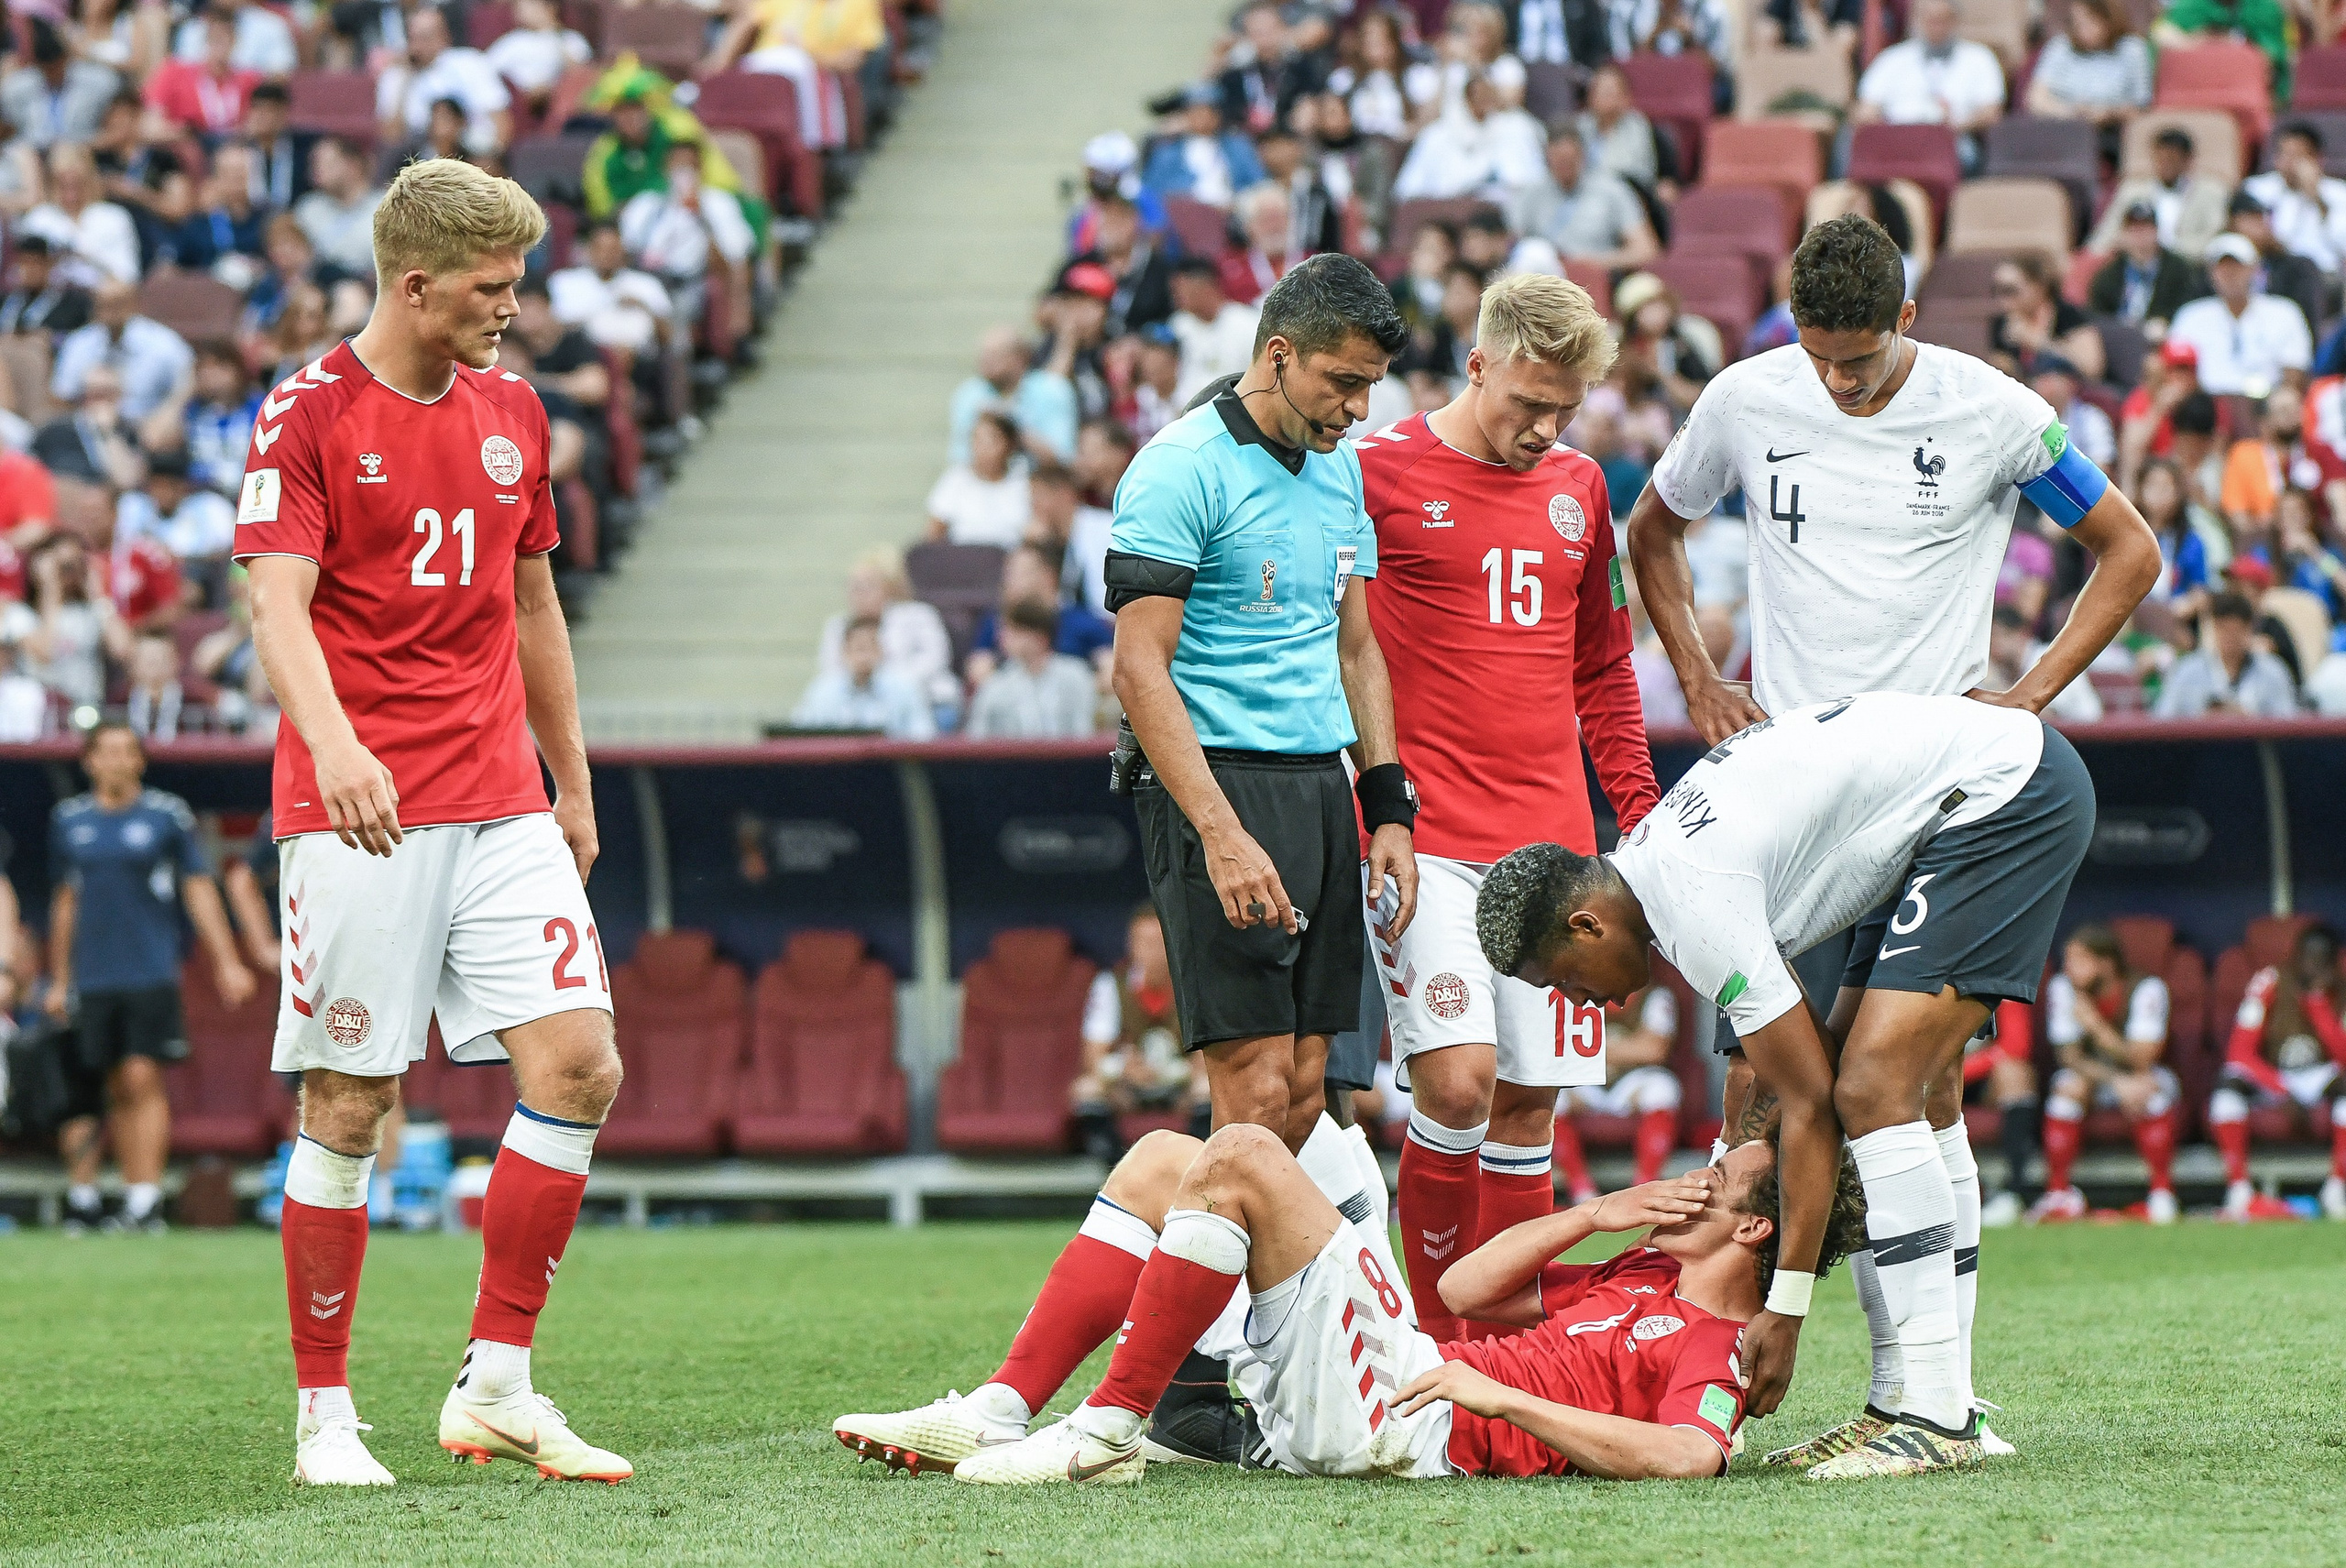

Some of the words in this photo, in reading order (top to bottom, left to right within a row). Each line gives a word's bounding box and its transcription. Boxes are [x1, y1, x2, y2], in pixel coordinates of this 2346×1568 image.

[1421, 519, 1455, 529] hummel
[1770, 475, 1805, 543] 4
[411, 507, 475, 587] 21
[1338, 551, 1356, 561] REFERE
[1336, 573, 1350, 587] FIF
[1481, 547, 1544, 627] 15
[1891, 873, 1937, 935] 3
[543, 916, 608, 992] 21
[334, 1014, 363, 1029] DBU
[1433, 987, 1463, 1003] DBU
[1548, 986, 1602, 1058] 15
[1358, 1247, 1403, 1319] 8
